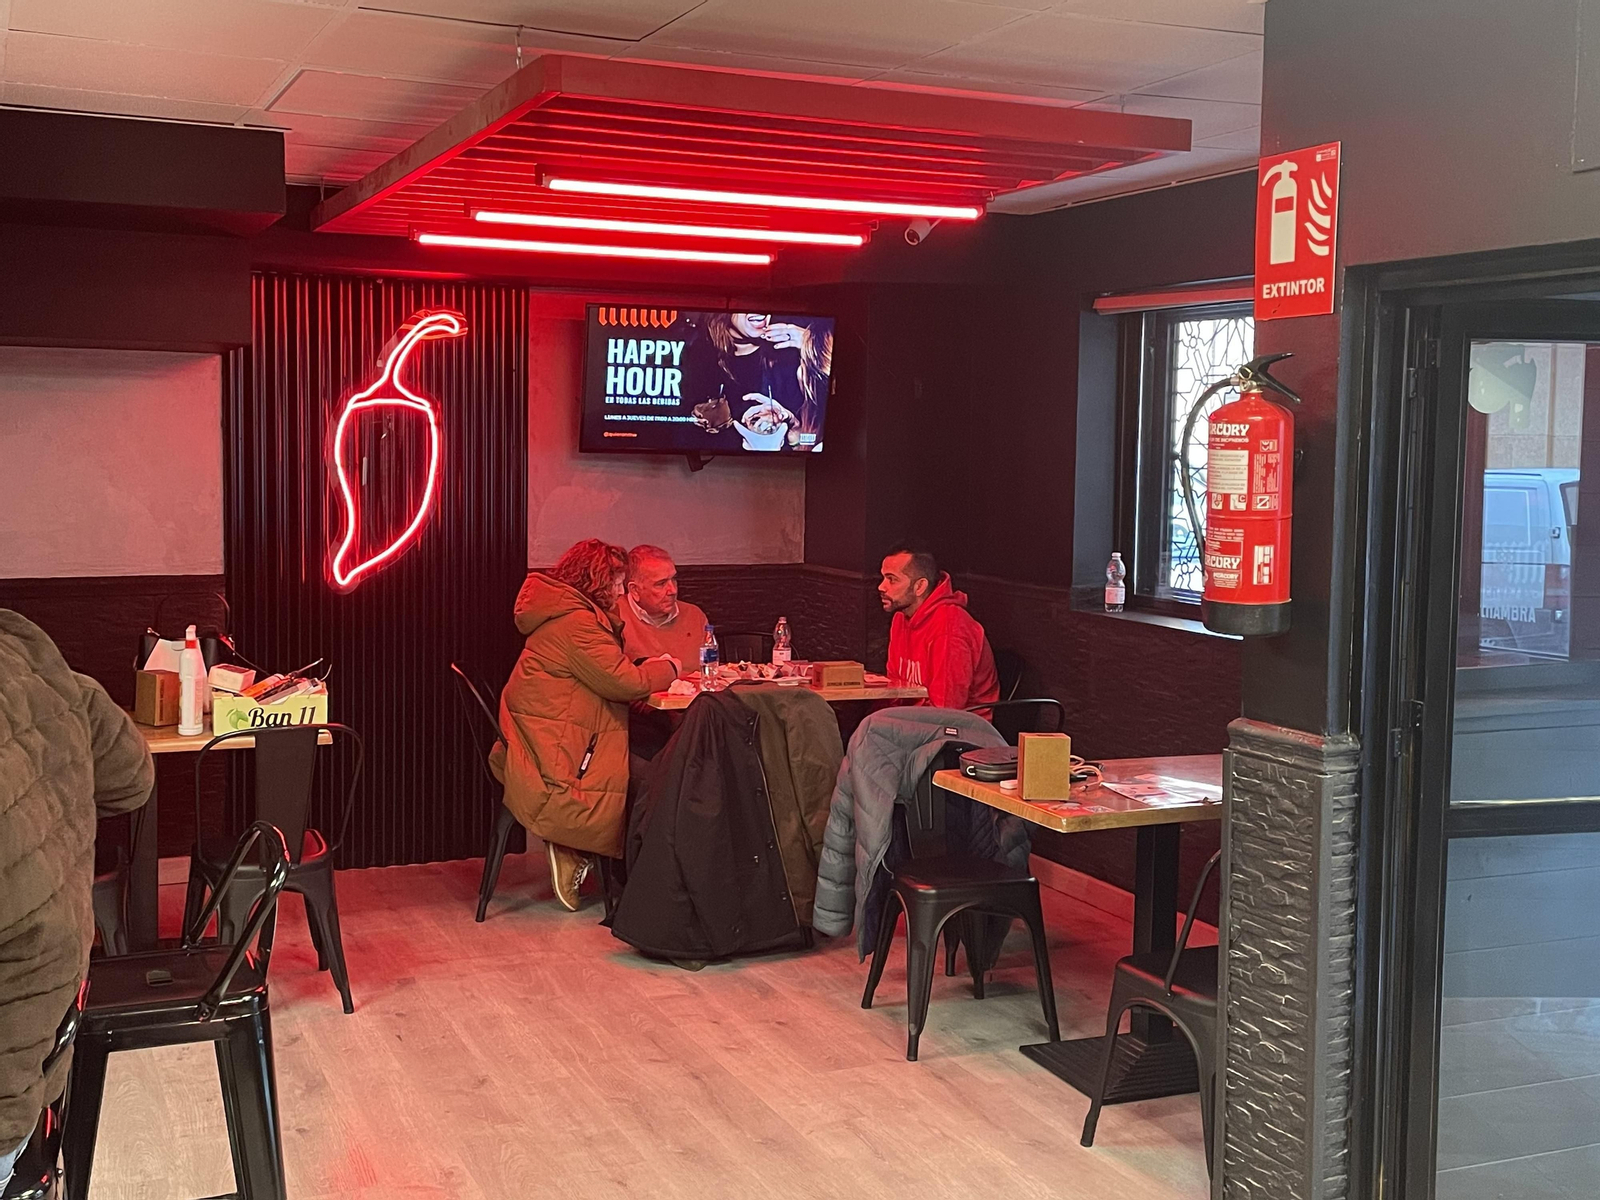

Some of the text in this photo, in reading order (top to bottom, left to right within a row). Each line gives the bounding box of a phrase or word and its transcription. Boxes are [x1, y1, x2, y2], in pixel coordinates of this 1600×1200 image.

[1262, 277, 1325, 299] EXTINTOR
[607, 338, 685, 366] HAPPY
[606, 366, 682, 397] HOUR
[605, 396, 680, 406] EN TODAS LAS BEBIDAS
[1209, 422, 1250, 436] RCURY
[1205, 554, 1241, 570] RCURY
[1477, 606, 1536, 623] LHAMBRA
